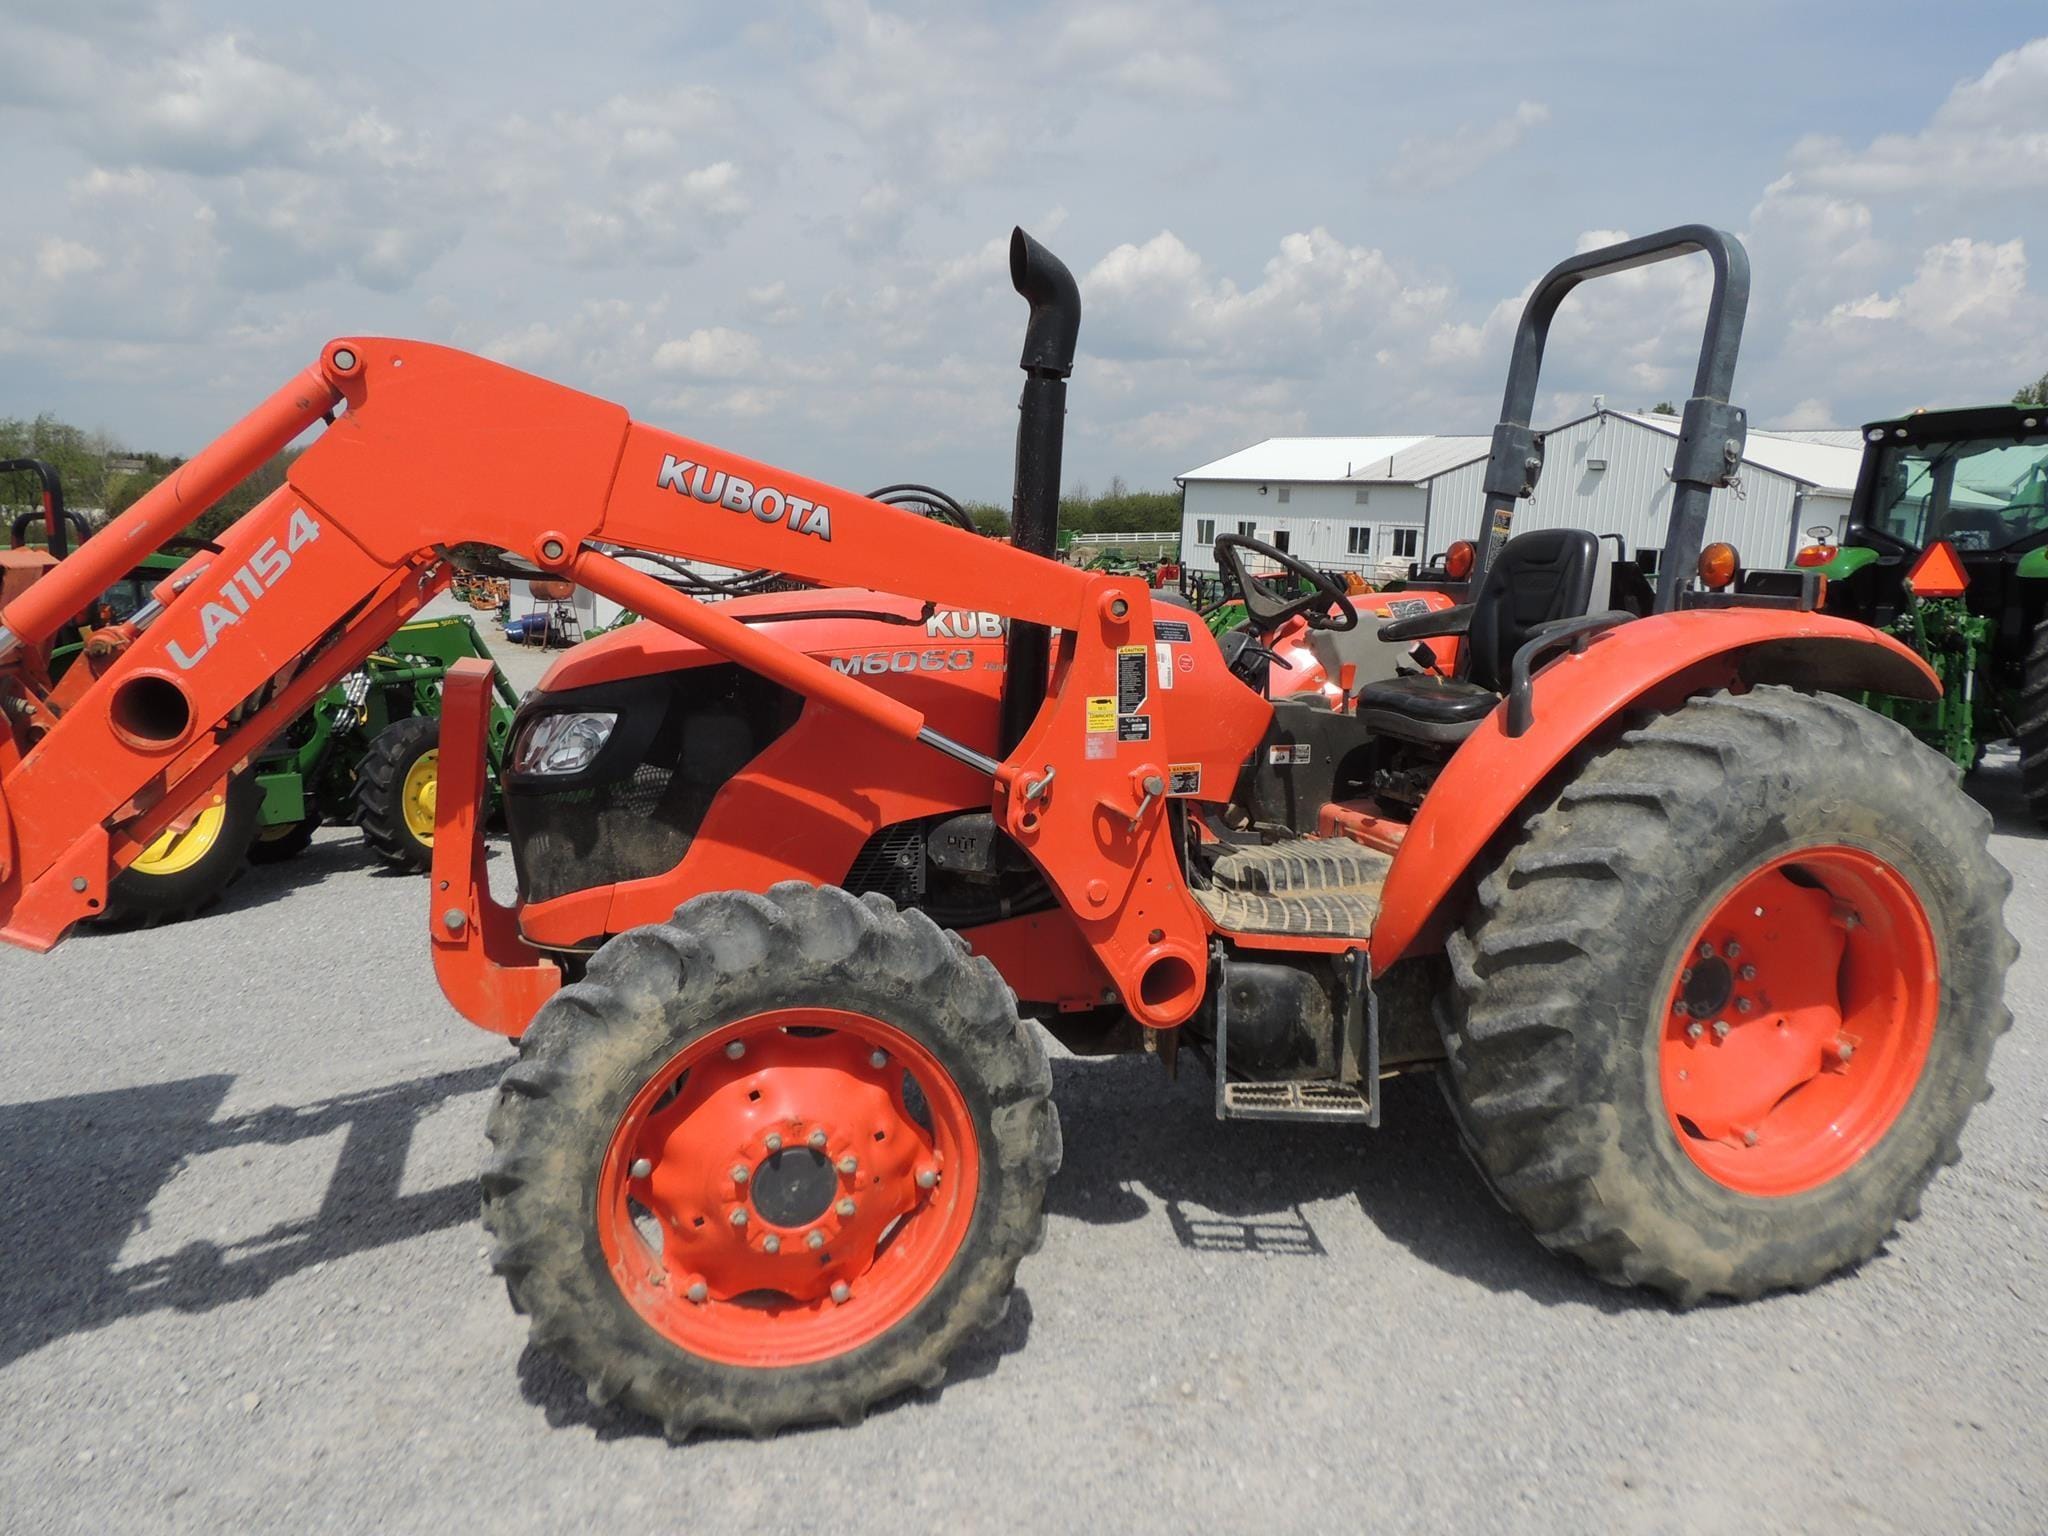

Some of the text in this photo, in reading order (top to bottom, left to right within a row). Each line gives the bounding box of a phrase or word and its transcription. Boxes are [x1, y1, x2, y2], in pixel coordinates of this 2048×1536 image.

[656, 453, 832, 542] KUBOTA
[165, 507, 321, 670] LA1154
[830, 649, 974, 676] M6060
